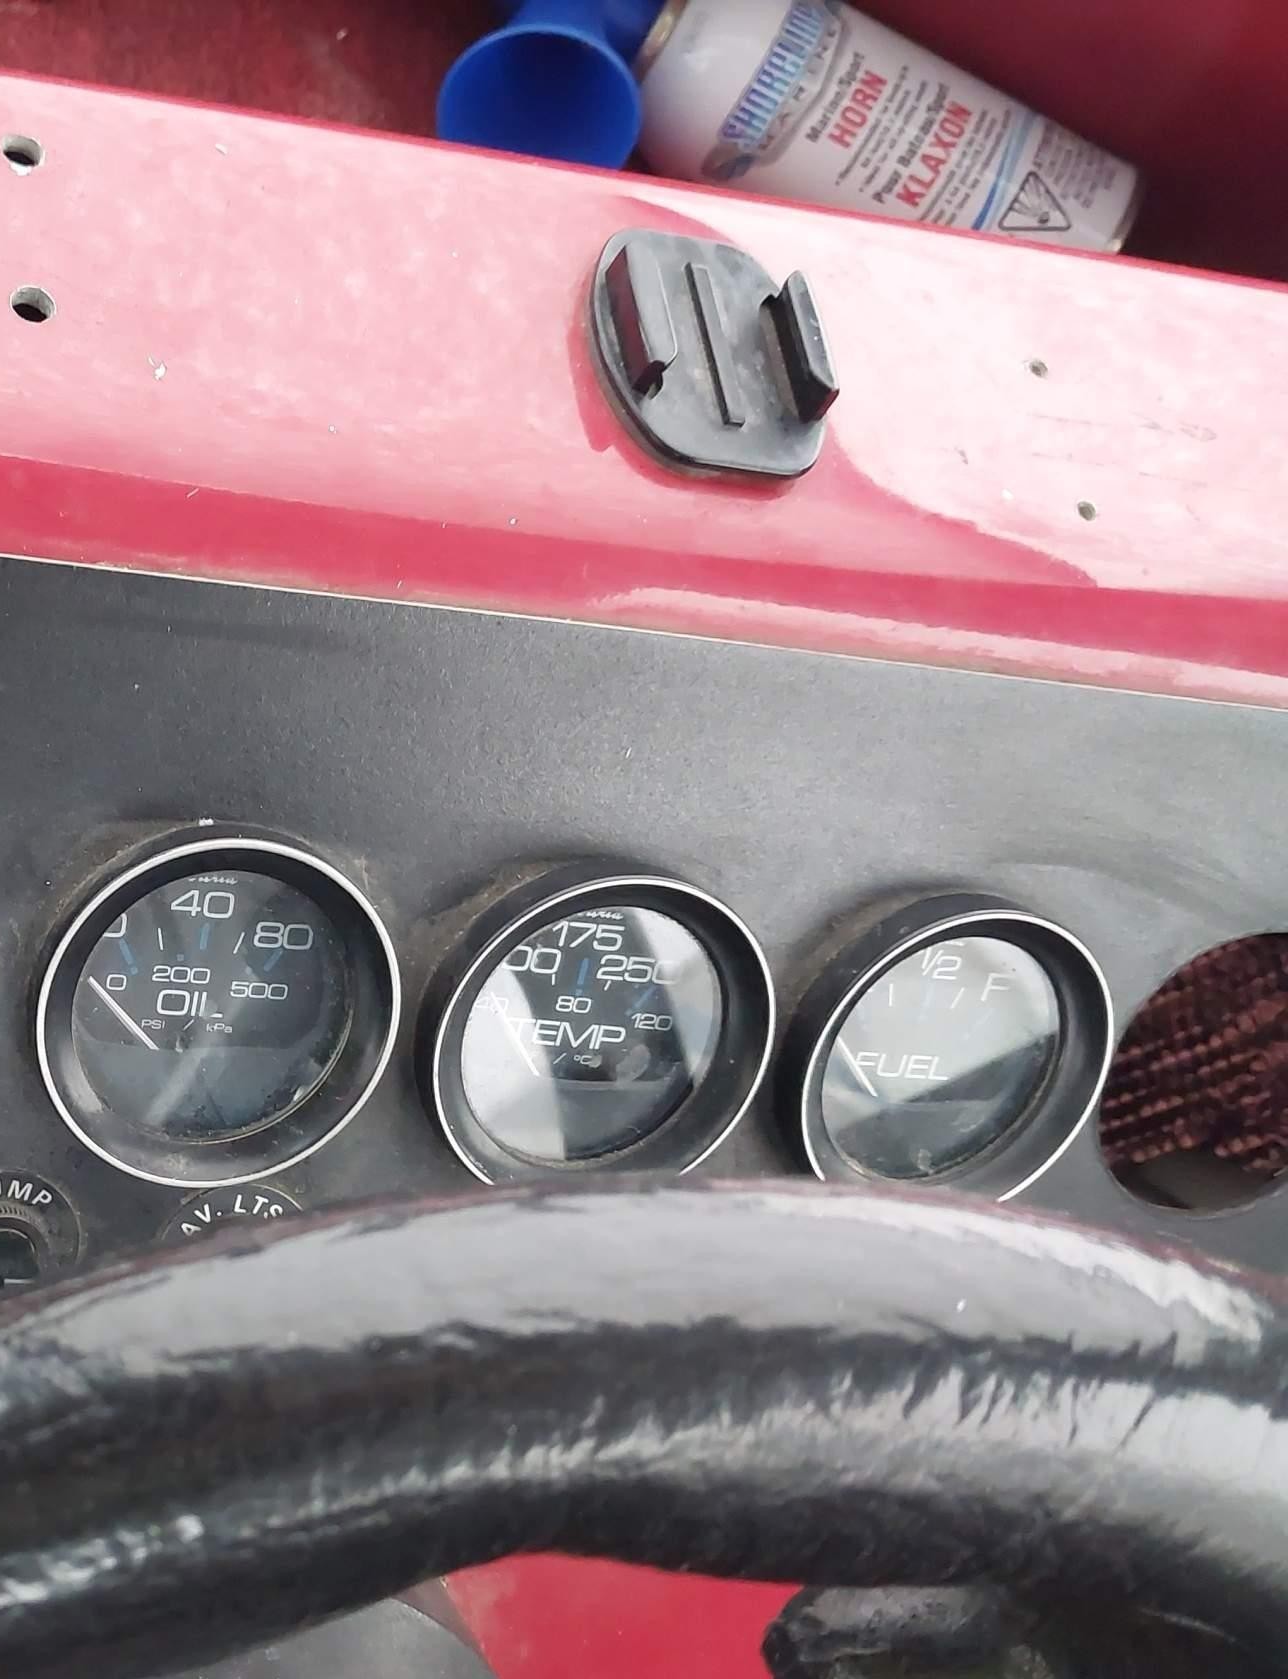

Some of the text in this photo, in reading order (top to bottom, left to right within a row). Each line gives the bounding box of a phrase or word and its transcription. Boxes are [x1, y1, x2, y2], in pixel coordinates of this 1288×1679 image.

[827, 70, 887, 148] HORN
[896, 100, 972, 208] KLAXON
[170, 889, 236, 919] 40
[253, 921, 314, 950] 80
[552, 921, 626, 952] 175
[151, 965, 211, 984] 200
[500, 945, 562, 975] 00
[596, 954, 679, 986] 250
[105, 973, 127, 991] 0
[229, 981, 289, 1000] 500
[156, 989, 224, 1018] OIL
[555, 995, 592, 1014] 80
[141, 1019, 166, 1030] PSI
[205, 1022, 233, 1034] kPa
[508, 1017, 627, 1051] TEMP
[630, 1012, 673, 1031] 120
[854, 1051, 949, 1081] FUEL
[180, 1203, 223, 1238] AV.
